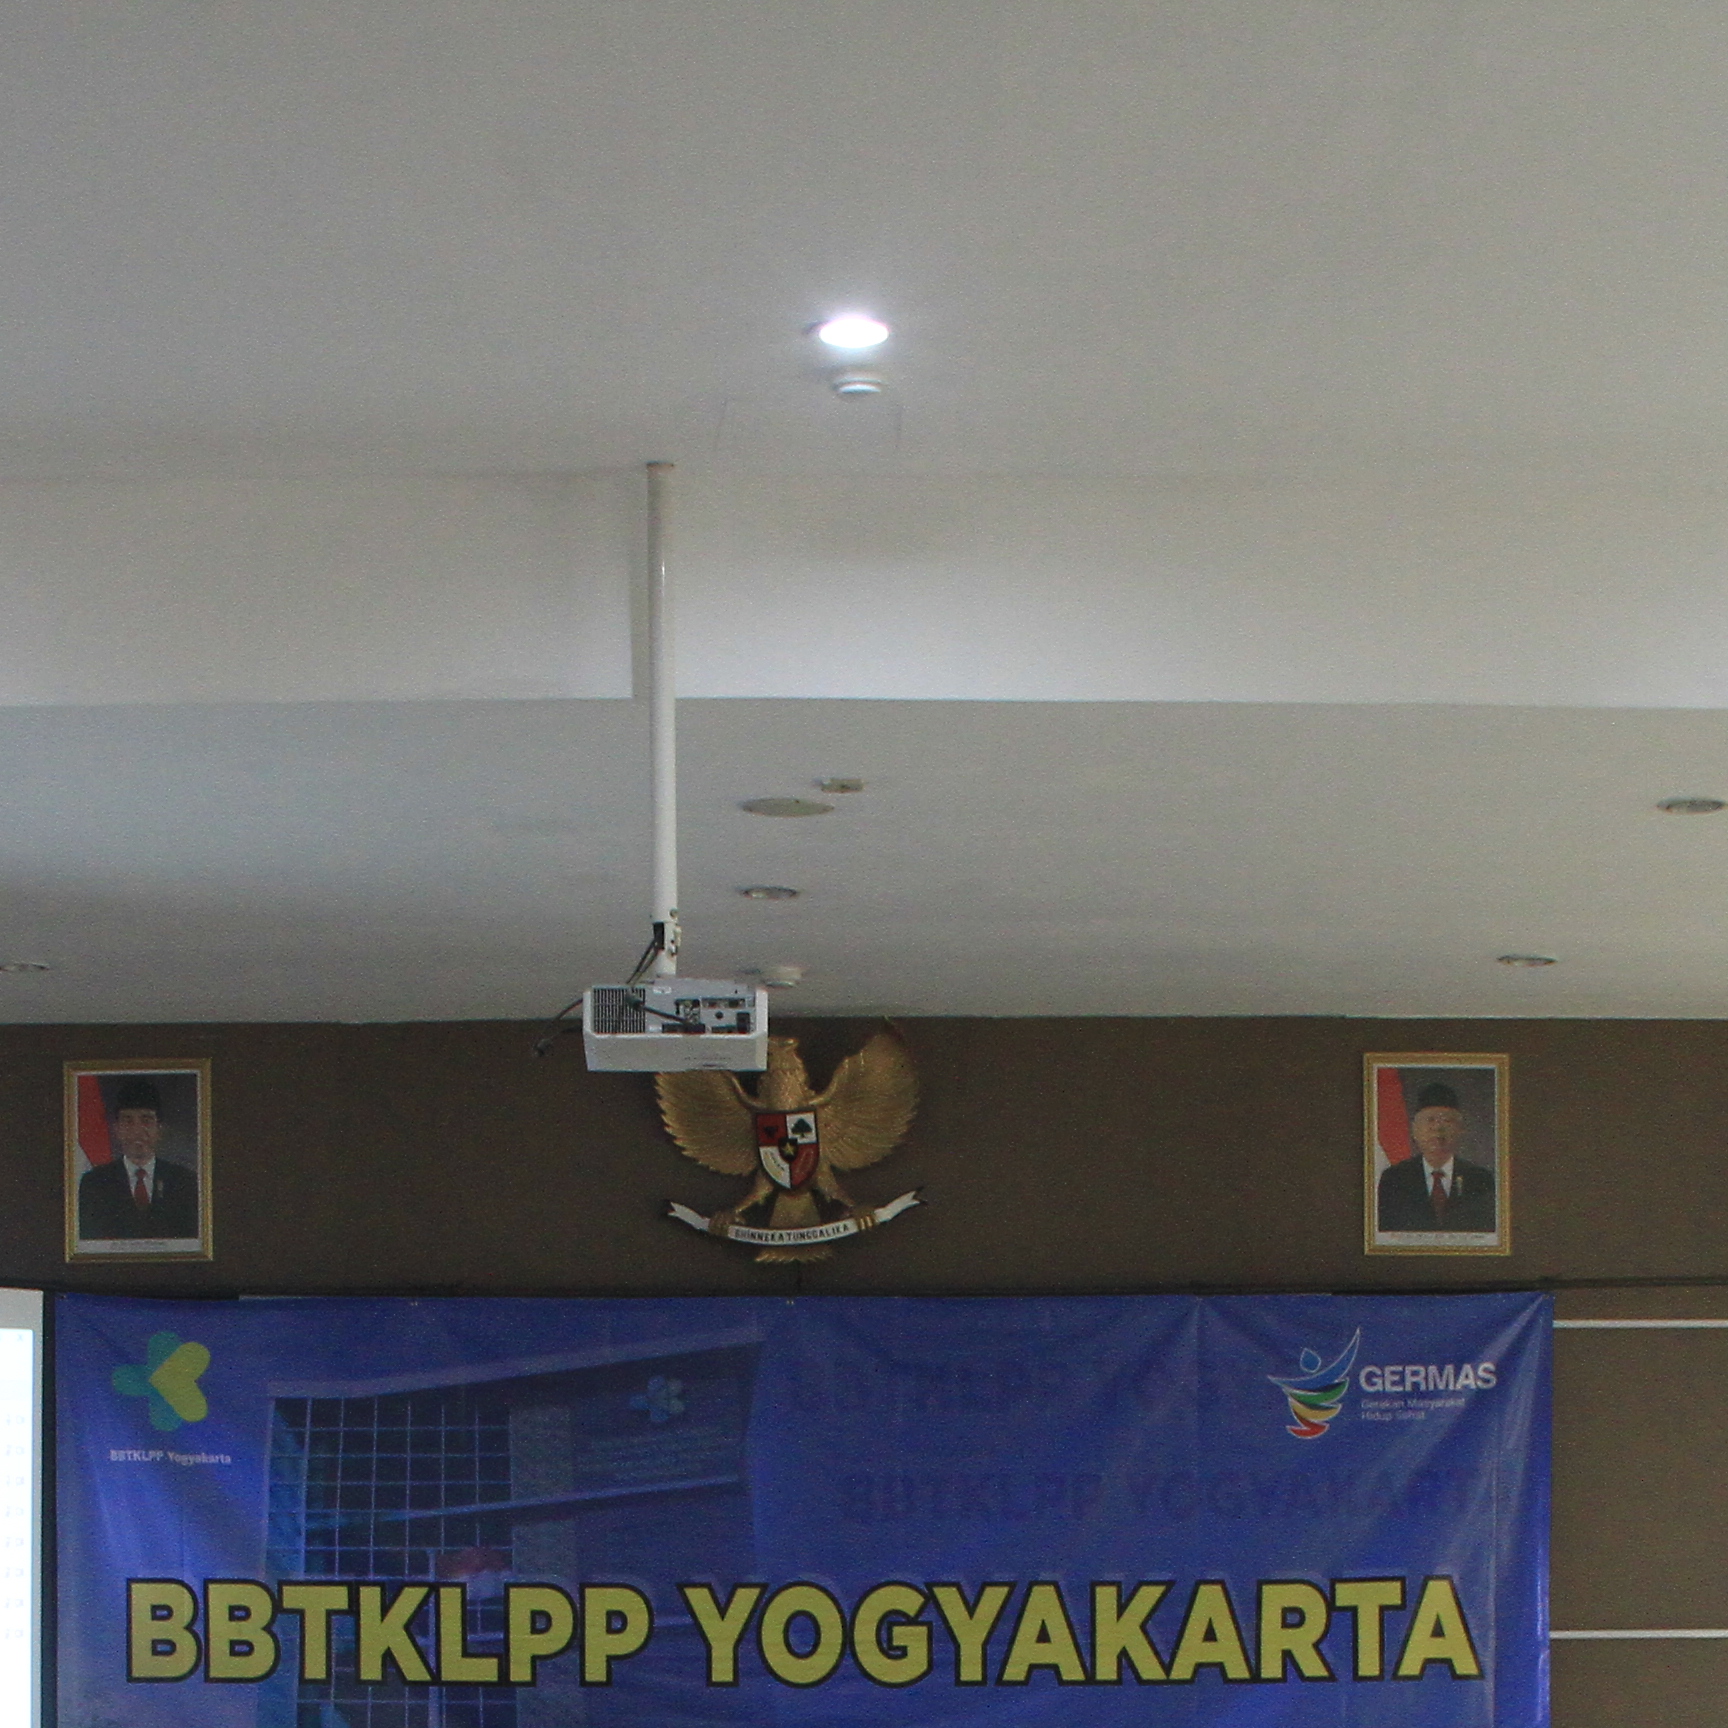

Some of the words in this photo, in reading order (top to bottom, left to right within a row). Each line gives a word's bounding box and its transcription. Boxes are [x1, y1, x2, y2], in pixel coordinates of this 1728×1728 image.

[1359, 1361, 1497, 1392] GERMAS
[110, 1449, 164, 1462] BBTKLPP
[166, 1450, 232, 1466] Yogyakarta
[126, 1578, 654, 1687] BBTKLPP
[677, 1574, 1485, 1688] YOGYAKARTA
